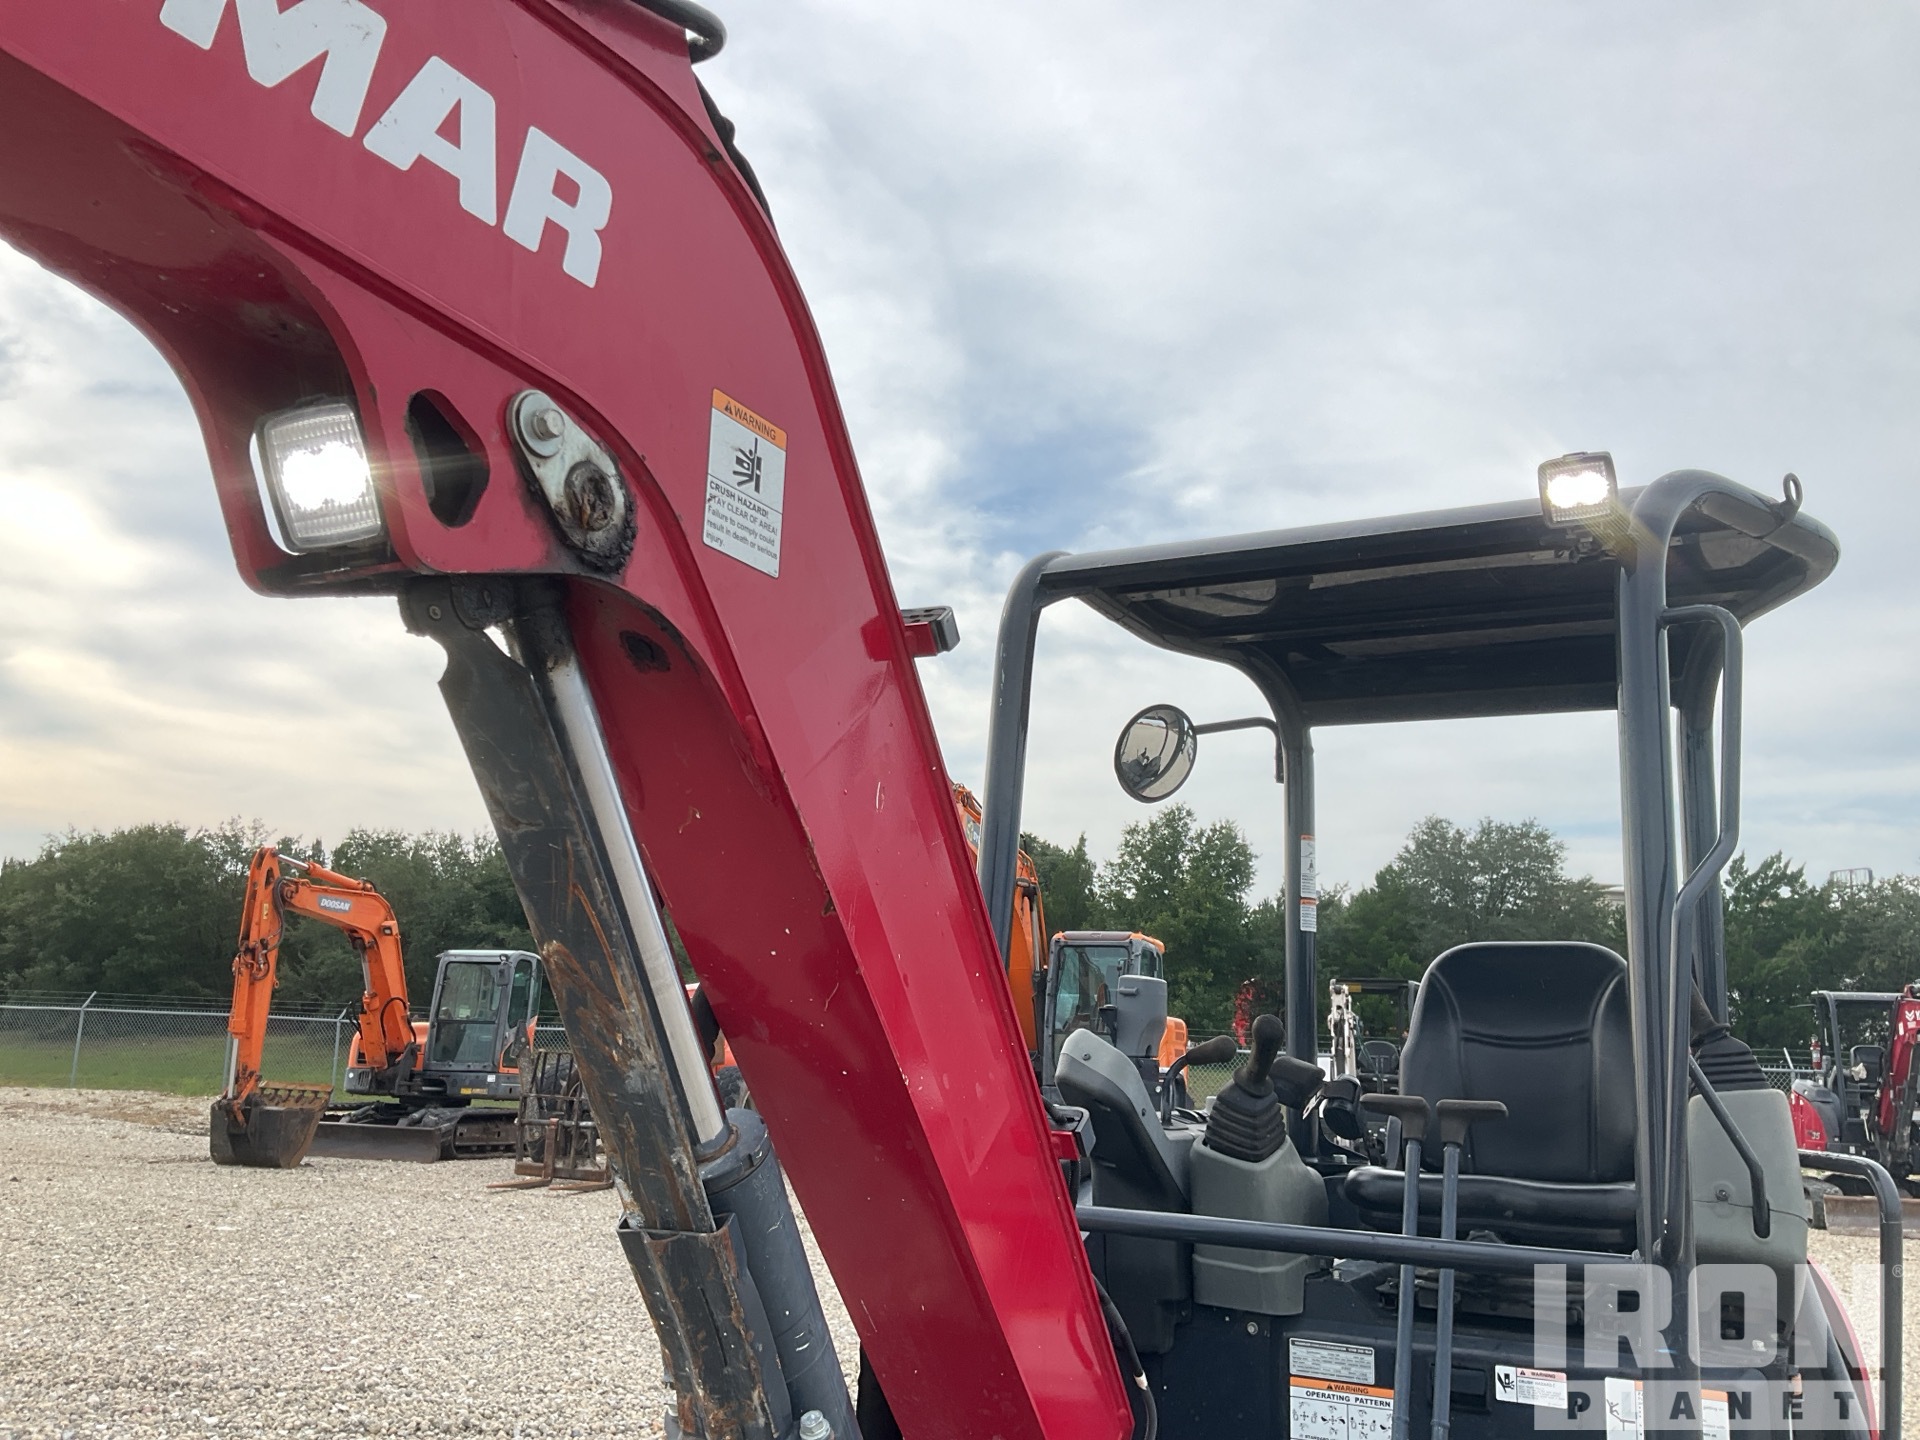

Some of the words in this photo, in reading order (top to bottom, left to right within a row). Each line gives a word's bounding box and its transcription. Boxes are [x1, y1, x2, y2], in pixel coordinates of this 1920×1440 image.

[733, 405, 776, 440] WARNING
[709, 481, 735, 500] CRUSH
[737, 495, 768, 518] HAZARD!
[708, 504, 728, 523] Failure
[736, 521, 758, 540] comply
[759, 533, 775, 546] could
[727, 502, 748, 520] CLEAR
[749, 514, 758, 525] OF
[759, 520, 778, 536] AREA!
[706, 519, 724, 533] result
[732, 531, 749, 545] death
[757, 545, 777, 560] serious
[320, 898, 350, 911] DOOSAN
[1305, 1390, 1351, 1402] OPERATING
[1354, 1397, 1391, 1408] PATTERN
[1333, 1384, 1369, 1394] WARNING
